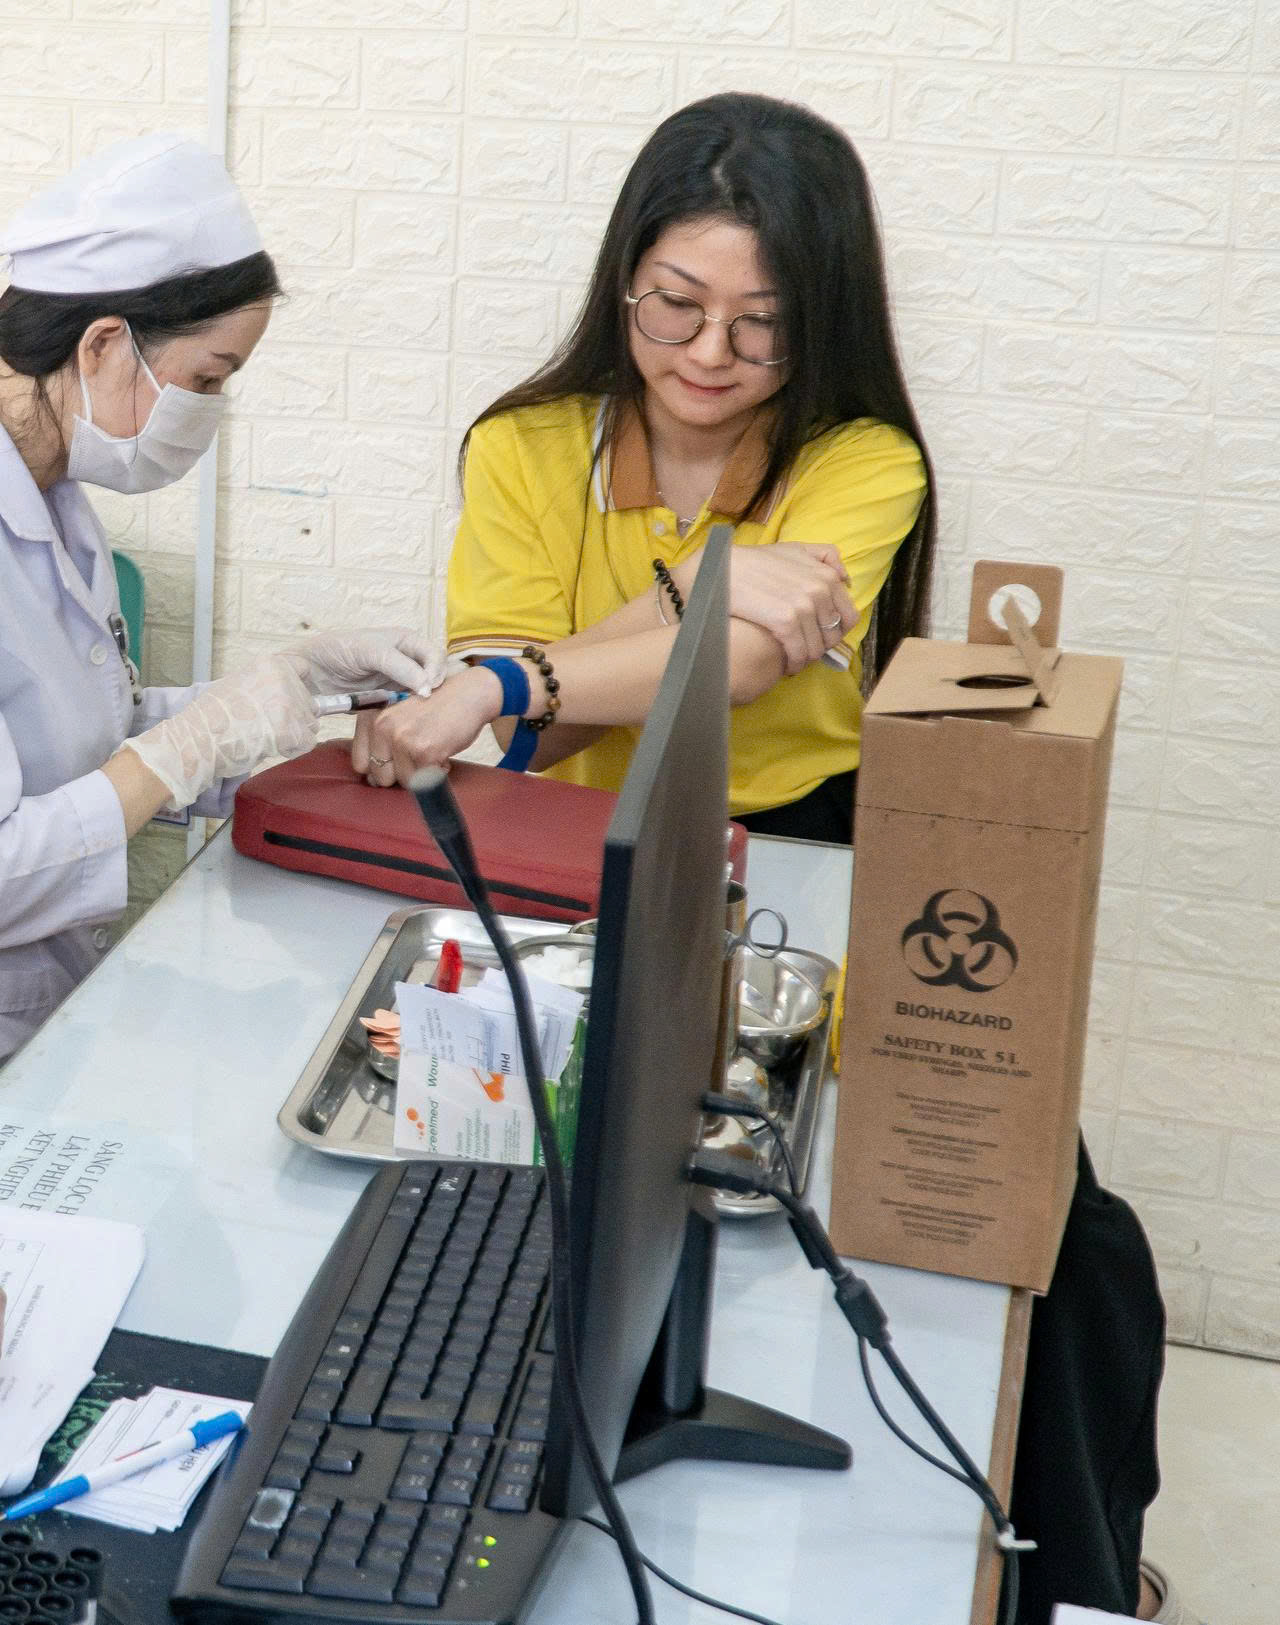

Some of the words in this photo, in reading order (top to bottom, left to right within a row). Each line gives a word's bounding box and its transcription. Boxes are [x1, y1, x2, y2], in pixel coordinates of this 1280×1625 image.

[895, 1001, 1014, 1031] BIOHAZARD
[884, 1034, 946, 1053] SAFETY
[950, 1046, 986, 1059] BOX
[501, 1053, 510, 1075] PHI
